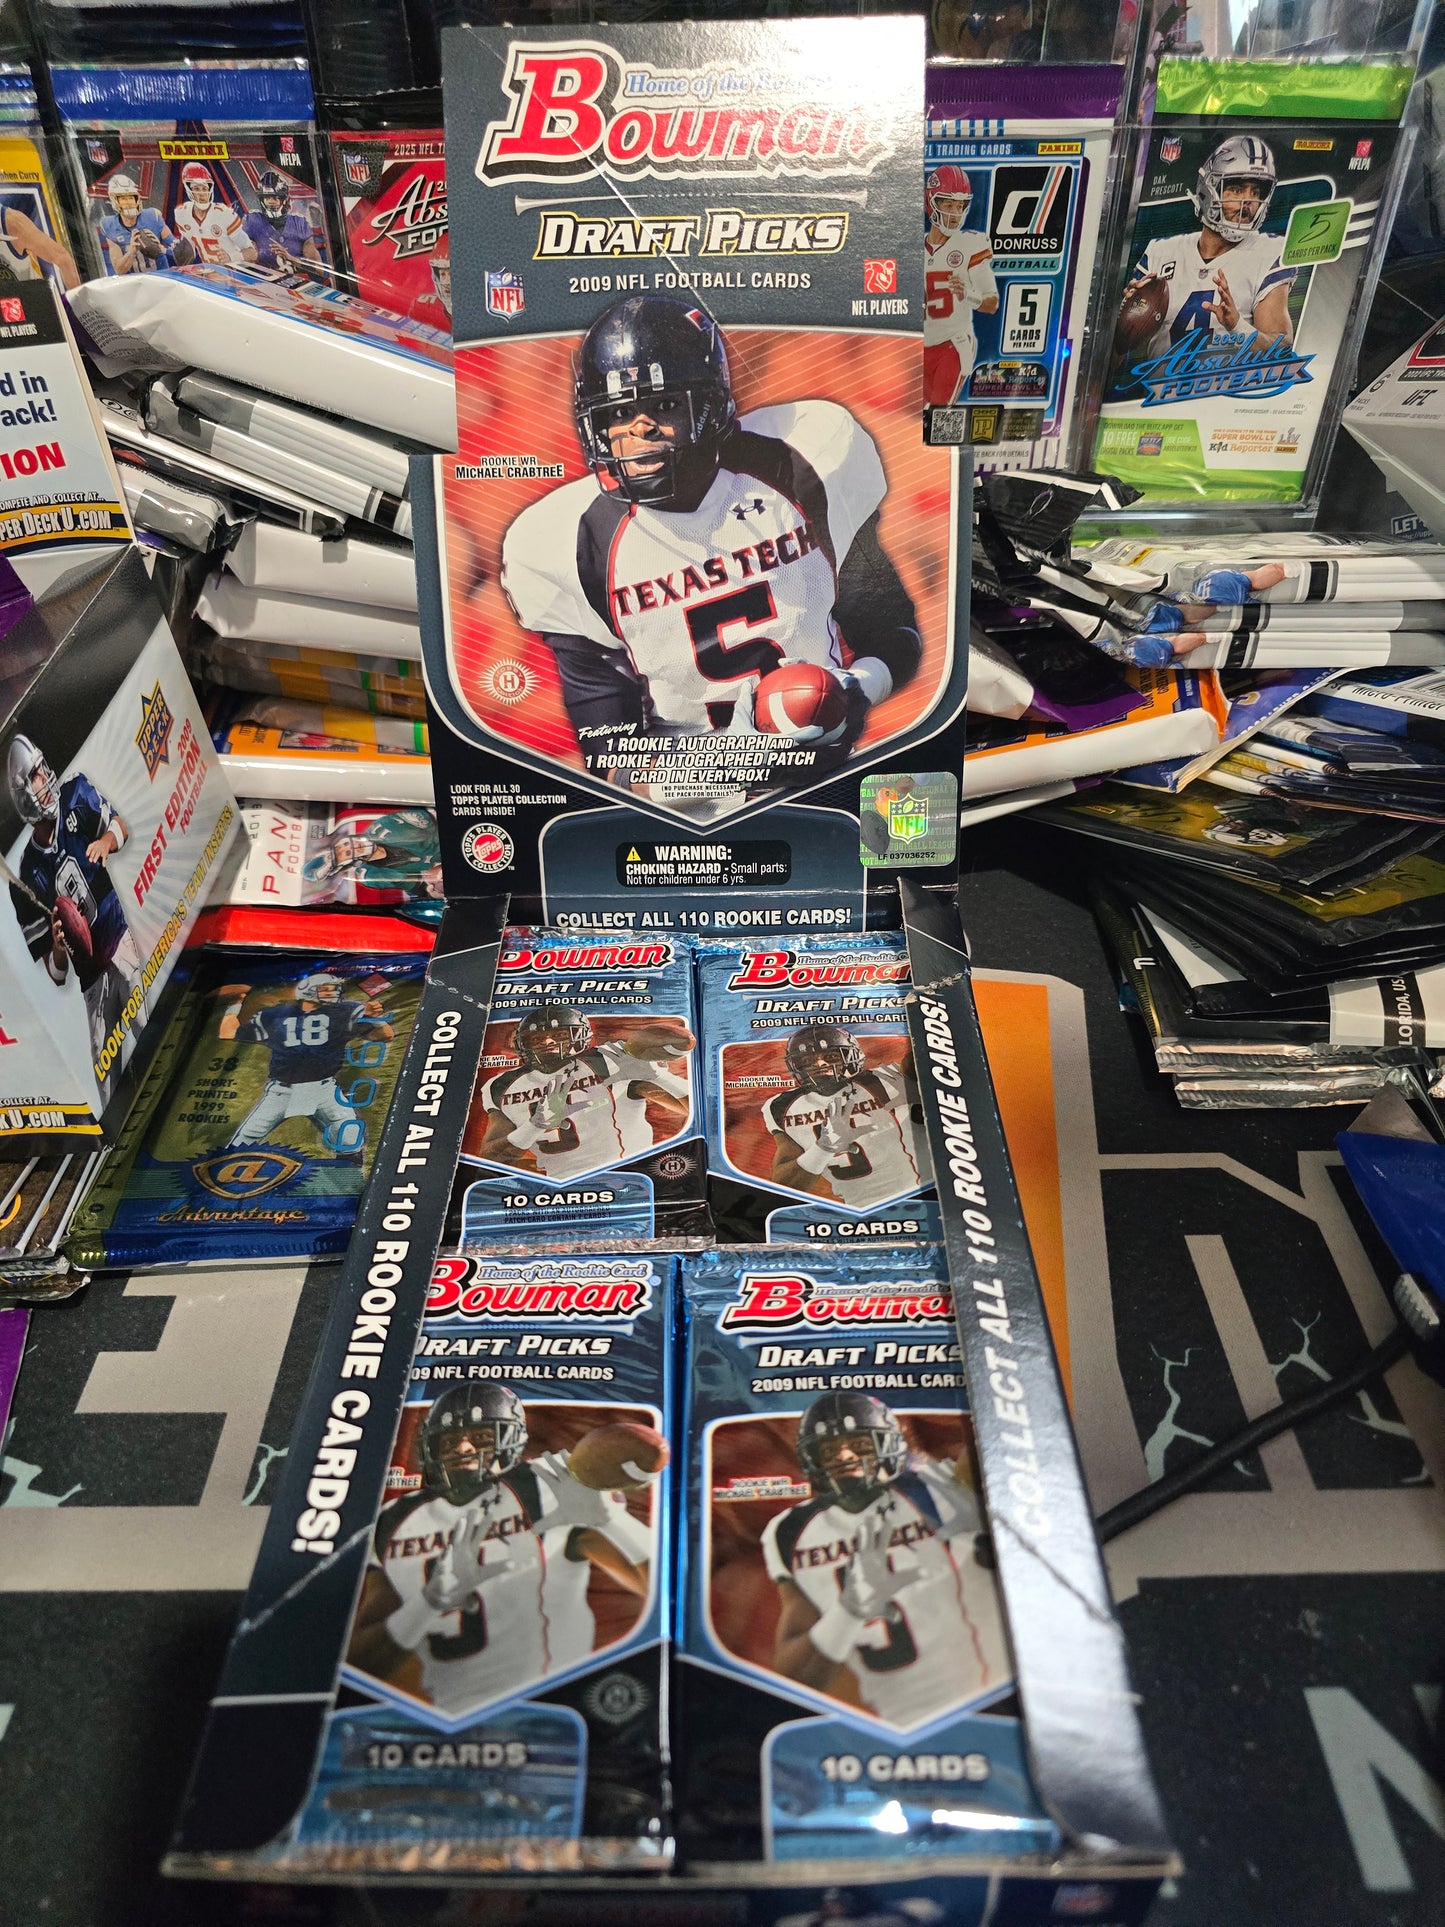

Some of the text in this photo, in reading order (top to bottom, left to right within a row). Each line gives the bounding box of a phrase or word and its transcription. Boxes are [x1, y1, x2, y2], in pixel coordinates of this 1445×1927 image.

[163, 144, 224, 156] PANINI
[394, 143, 435, 156] 2025 NFL
[936, 144, 1011, 156] TRADING CARDS
[1040, 144, 1080, 153] PANINI
[279, 153, 302, 167] NFLPA
[1348, 157, 1371, 171] NFLPA
[19, 171, 40, 182] Curry
[350, 165, 371, 182] NFL
[1153, 175, 1167, 185] DAK
[1151, 183, 1183, 196] PRESCOTT
[534, 209, 849, 259] DRAFT PICKS
[1298, 211, 1339, 244] 5
[993, 238, 1058, 250] DONRUSS
[1288, 244, 1337, 258] CARDS PER PACK
[992, 260, 1057, 269] FOOTBALL
[569, 272, 812, 293] 2009 NFL FOOTBALL CARDS
[851, 299, 909, 317] NFL PLAYERS
[1018, 288, 1039, 326] 5
[1, 325, 38, 338] NFL PLAYERS
[1010, 329, 1041, 341] CARDS
[1212, 332, 1246, 346] 2020
[1114, 327, 1298, 390] Absolute
[20, 370, 49, 394] in
[1160, 364, 1297, 399] FOOTBALL
[1369, 373, 1392, 393] 6
[1402, 390, 1438, 406] UFC
[1104, 422, 1135, 430] DOWNLOAD
[1115, 431, 1138, 446] FREE
[1211, 433, 1240, 441] SUPER
[1209, 442, 1228, 452] Kid
[1230, 444, 1273, 453] Reporter
[481, 456, 538, 468] ROOKIE WR
[456, 464, 565, 480] MICHAEL CRABTREE
[33, 493, 85, 506] AND COLLECT
[612, 556, 730, 618] TEXAS
[138, 691, 165, 754] UPPER
[146, 706, 174, 768] DECK
[177, 717, 193, 760] 2009
[577, 722, 639, 742] Featuring
[606, 735, 794, 752] 1 ROOKIE AUTOGRAPH AND
[585, 751, 817, 769] 1 ROOKIE AUTOGRAPHED PATCH
[629, 768, 771, 784] CARD IN EVERY BOX!
[179, 759, 209, 836] FOOTBALL
[450, 784, 521, 795] LOOK FOR ALL 30
[450, 794, 567, 805] TOPPS PLAYER COLLECTION
[452, 806, 516, 816] CARDS INSIDE!
[132, 733, 202, 908] FIRST EDITION
[654, 845, 732, 861] WARNING:
[625, 862, 758, 875] CHOKING HAZARD Small
[626, 873, 729, 885] Not for children under 6
[556, 908, 852, 928] COLLECT ALL 110 ROOKIE CARDS!
[93, 800, 235, 1083] LOOK FOR AMERICA'S TEAM INSERTS!
[494, 979, 650, 995] DRAFT PICKS
[519, 995, 653, 1008] NFL FOOTBALL CARDS
[754, 999, 834, 1014] DRAFT
[751, 1015, 873, 1028] 2009 NFL FOOTBALL
[281, 1013, 332, 1048] 18
[208, 1056, 239, 1072] 38
[195, 1078, 238, 1087] SHORT-
[322, 1011, 396, 1152] 1999
[725, 1080, 795, 1089] MICHAEL CRABTREE
[187, 1089, 238, 1099] PRINTED
[193, 1101, 225, 1112] 1999
[177, 1113, 231, 1124] ROOKIES
[502, 1191, 615, 1208] 10 CARDS
[157, 1205, 309, 1224] Advantage
[940, 1092, 1009, 1344] ROOKIE 110 ALL
[804, 1220, 920, 1237] 10 CARDS
[479, 1264, 647, 1282] Home of the Rookie Card
[289, 1009, 463, 1556] COLLECT ALL 110 ROOKIE CARDS!
[516, 1334, 613, 1355] PICKS
[757, 1346, 867, 1368] DRAFT
[432, 1365, 615, 1380] NFL FOOTBALL CARDS
[751, 1374, 914, 1393] 2009 NFL FOOTBALL
[368, 1741, 528, 1769] 10 CARDS
[821, 1753, 989, 1782] 10 CARDS
